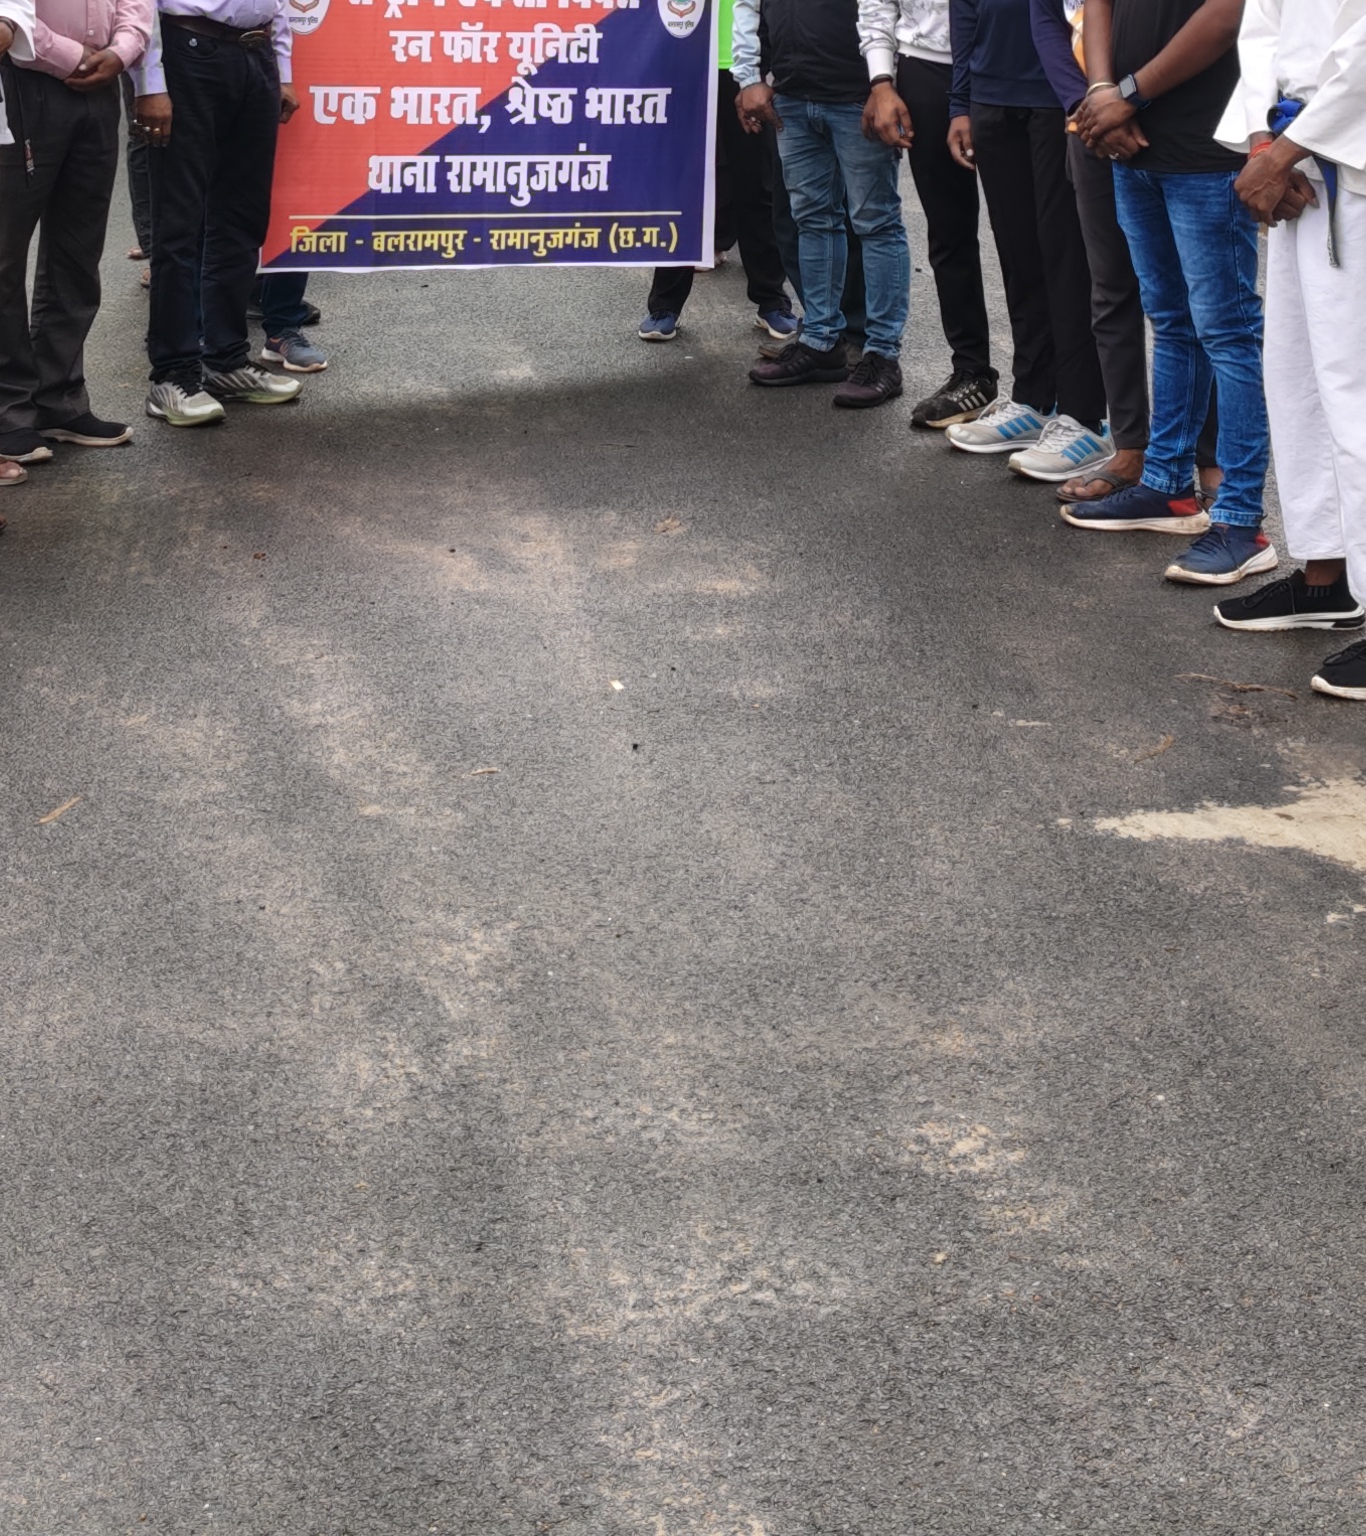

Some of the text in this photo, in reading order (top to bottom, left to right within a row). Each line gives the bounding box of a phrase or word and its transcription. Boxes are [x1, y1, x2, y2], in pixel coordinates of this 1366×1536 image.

[390, 22, 603, 76] रन फॉर यूनिटी
[309, 76, 672, 133] एक भारत, श्रेष्ठ भारत
[368, 142, 612, 207] थाना रामानुजगंज
[290, 226, 348, 253] जिला
[372, 229, 467, 258] बलरामपुर
[489, 222, 601, 257] रामानुजगंज
[608, 222, 678, 253] (छ.ग.)
